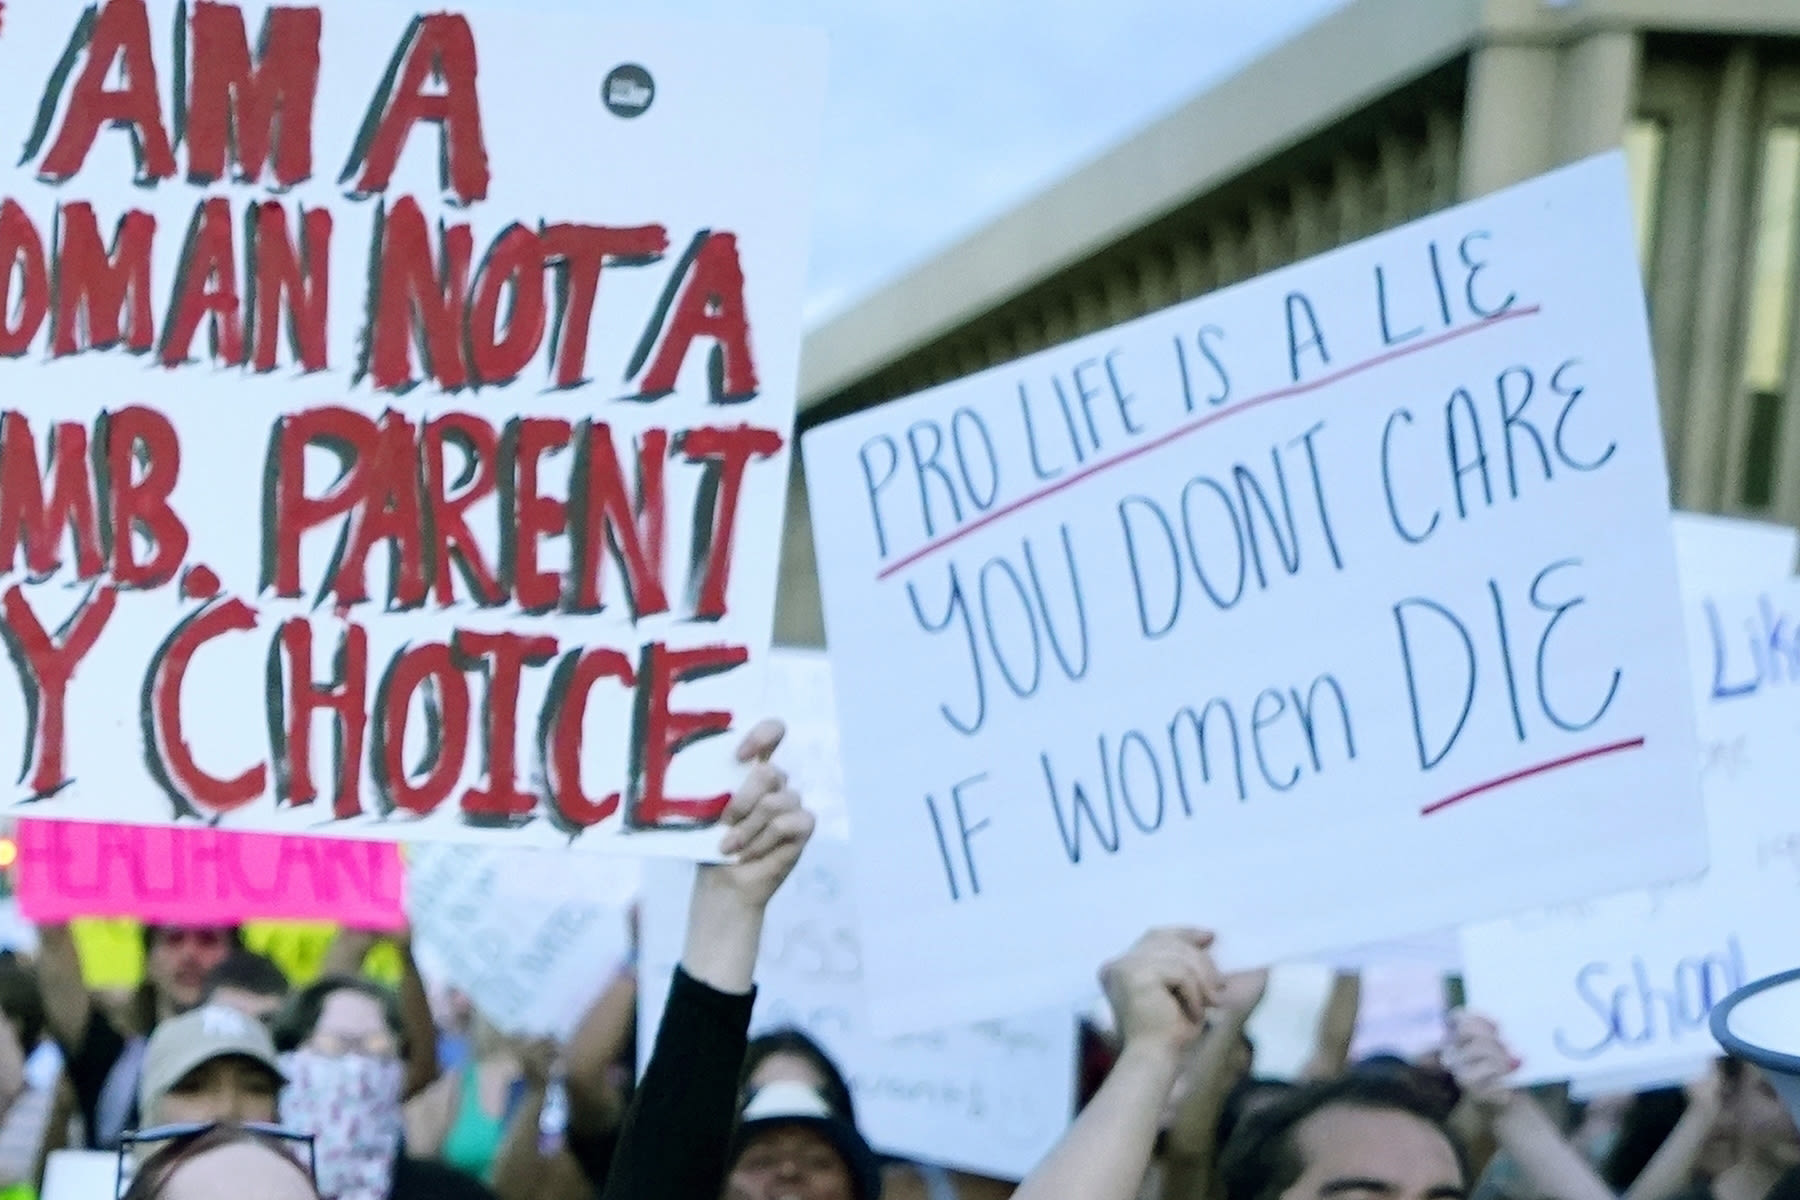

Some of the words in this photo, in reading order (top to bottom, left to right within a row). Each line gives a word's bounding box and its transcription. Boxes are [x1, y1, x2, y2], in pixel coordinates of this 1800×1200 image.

[19, 0, 322, 190] AM
[339, 9, 491, 205] A
[352, 197, 668, 392] NOT
[624, 227, 760, 402] A
[859, 407, 998, 558] PRO
[1016, 346, 1146, 483] LIFE
[1172, 324, 1230, 412] IS
[1285, 291, 1331, 382] A
[1375, 229, 1517, 347] LIE
[260, 404, 784, 621] PARENT
[906, 523, 1089, 736] YOU
[1116, 420, 1343, 640] DONT
[1380, 359, 1617, 544] CARE
[140, 598, 748, 840] CHOICE
[924, 771, 991, 901] IF
[1392, 558, 1622, 772] DIE
